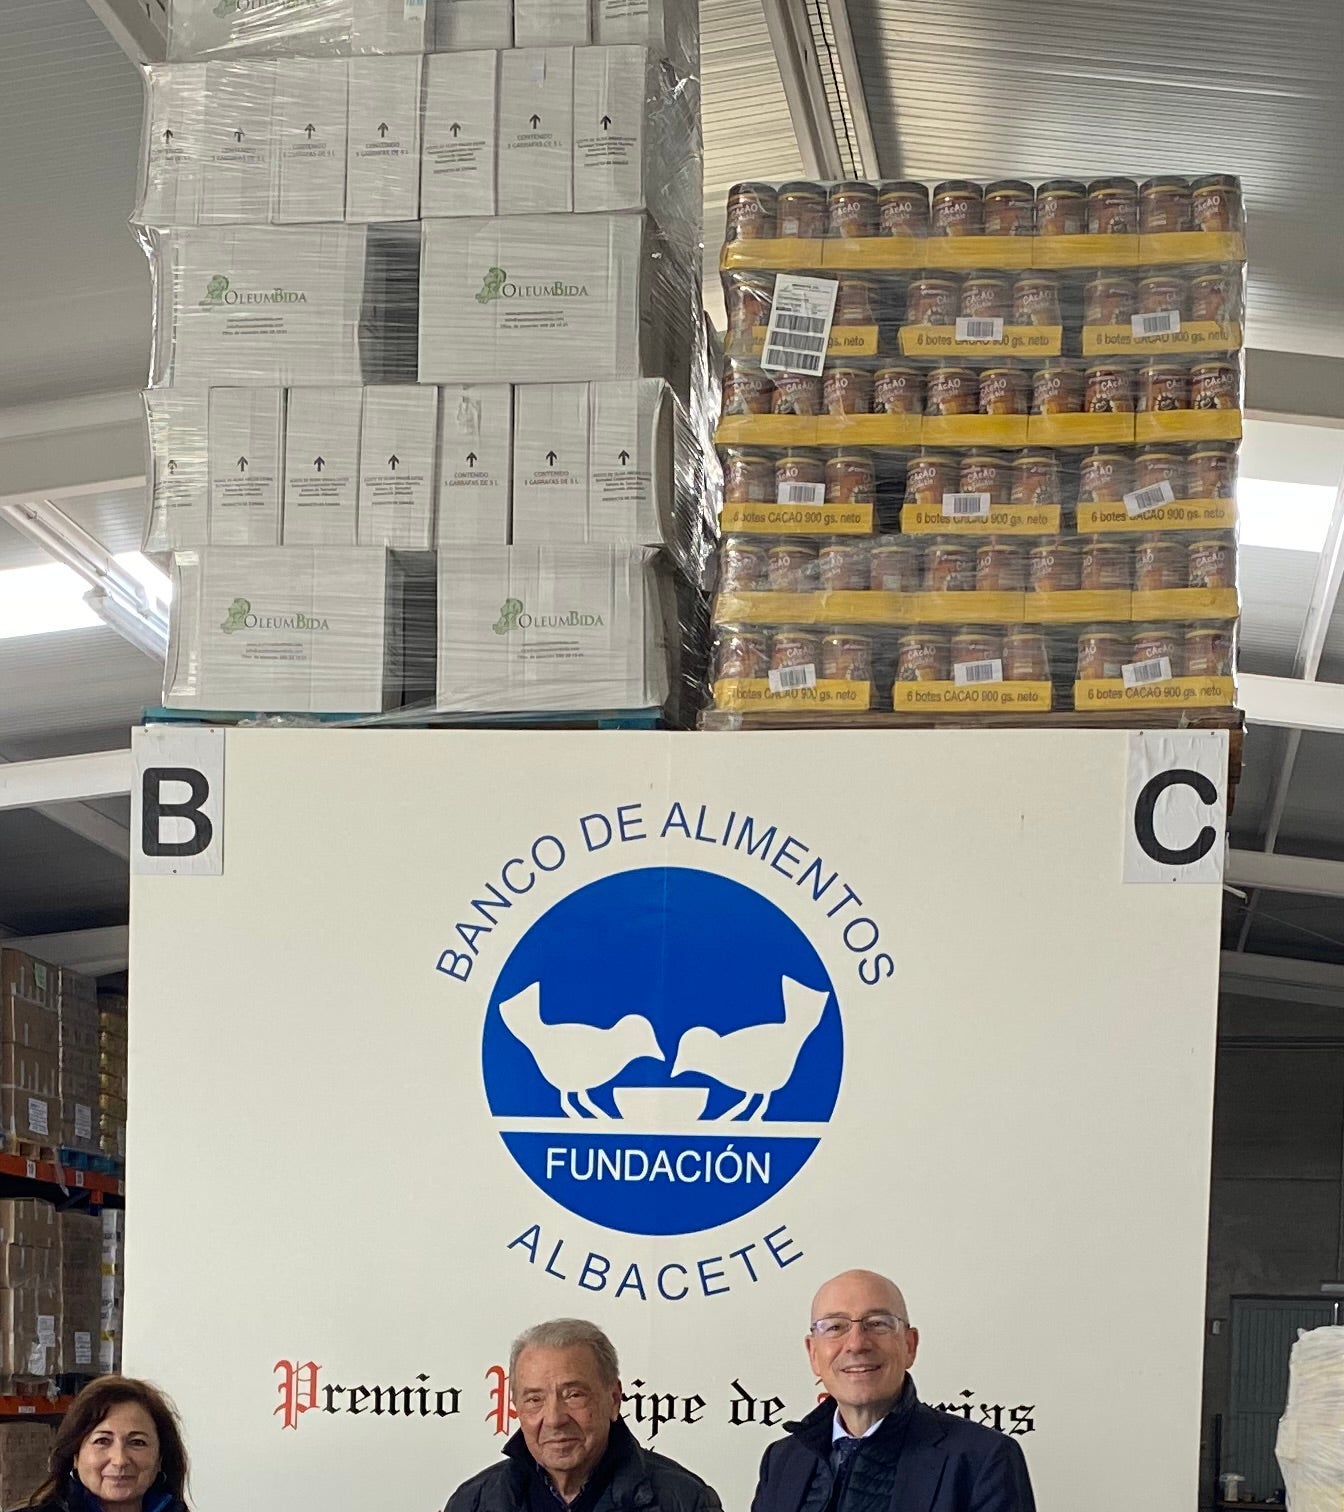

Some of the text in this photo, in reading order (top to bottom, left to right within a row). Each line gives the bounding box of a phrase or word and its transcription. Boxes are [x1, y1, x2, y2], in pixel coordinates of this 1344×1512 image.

[768, 512, 802, 523] CACAO
[806, 512, 822, 522] 900
[840, 512, 860, 523] neto
[1091, 512, 1097, 522] 6
[1100, 512, 1126, 522] botes
[1167, 508, 1184, 520] 900
[1204, 508, 1224, 520] neto
[907, 690, 912, 700] 6
[915, 690, 942, 701] botes
[944, 690, 979, 702] CACAO
[982, 690, 998, 701] 900
[1018, 691, 1038, 702] neto
[1088, 690, 1094, 700] 6
[1096, 688, 1122, 700] botes
[1125, 687, 1161, 698] CACAO
[1163, 687, 1181, 697] 900
[141, 767, 214, 857] B
[1134, 768, 1218, 866] C
[435, 802, 895, 986] BANCO DE ALIMENTOS
[546, 1144, 770, 1184] FUNDACIÓN
[506, 1224, 804, 1301] ALBACETE
[273, 1359, 463, 1430] Premio
[728, 1378, 786, 1427] de
